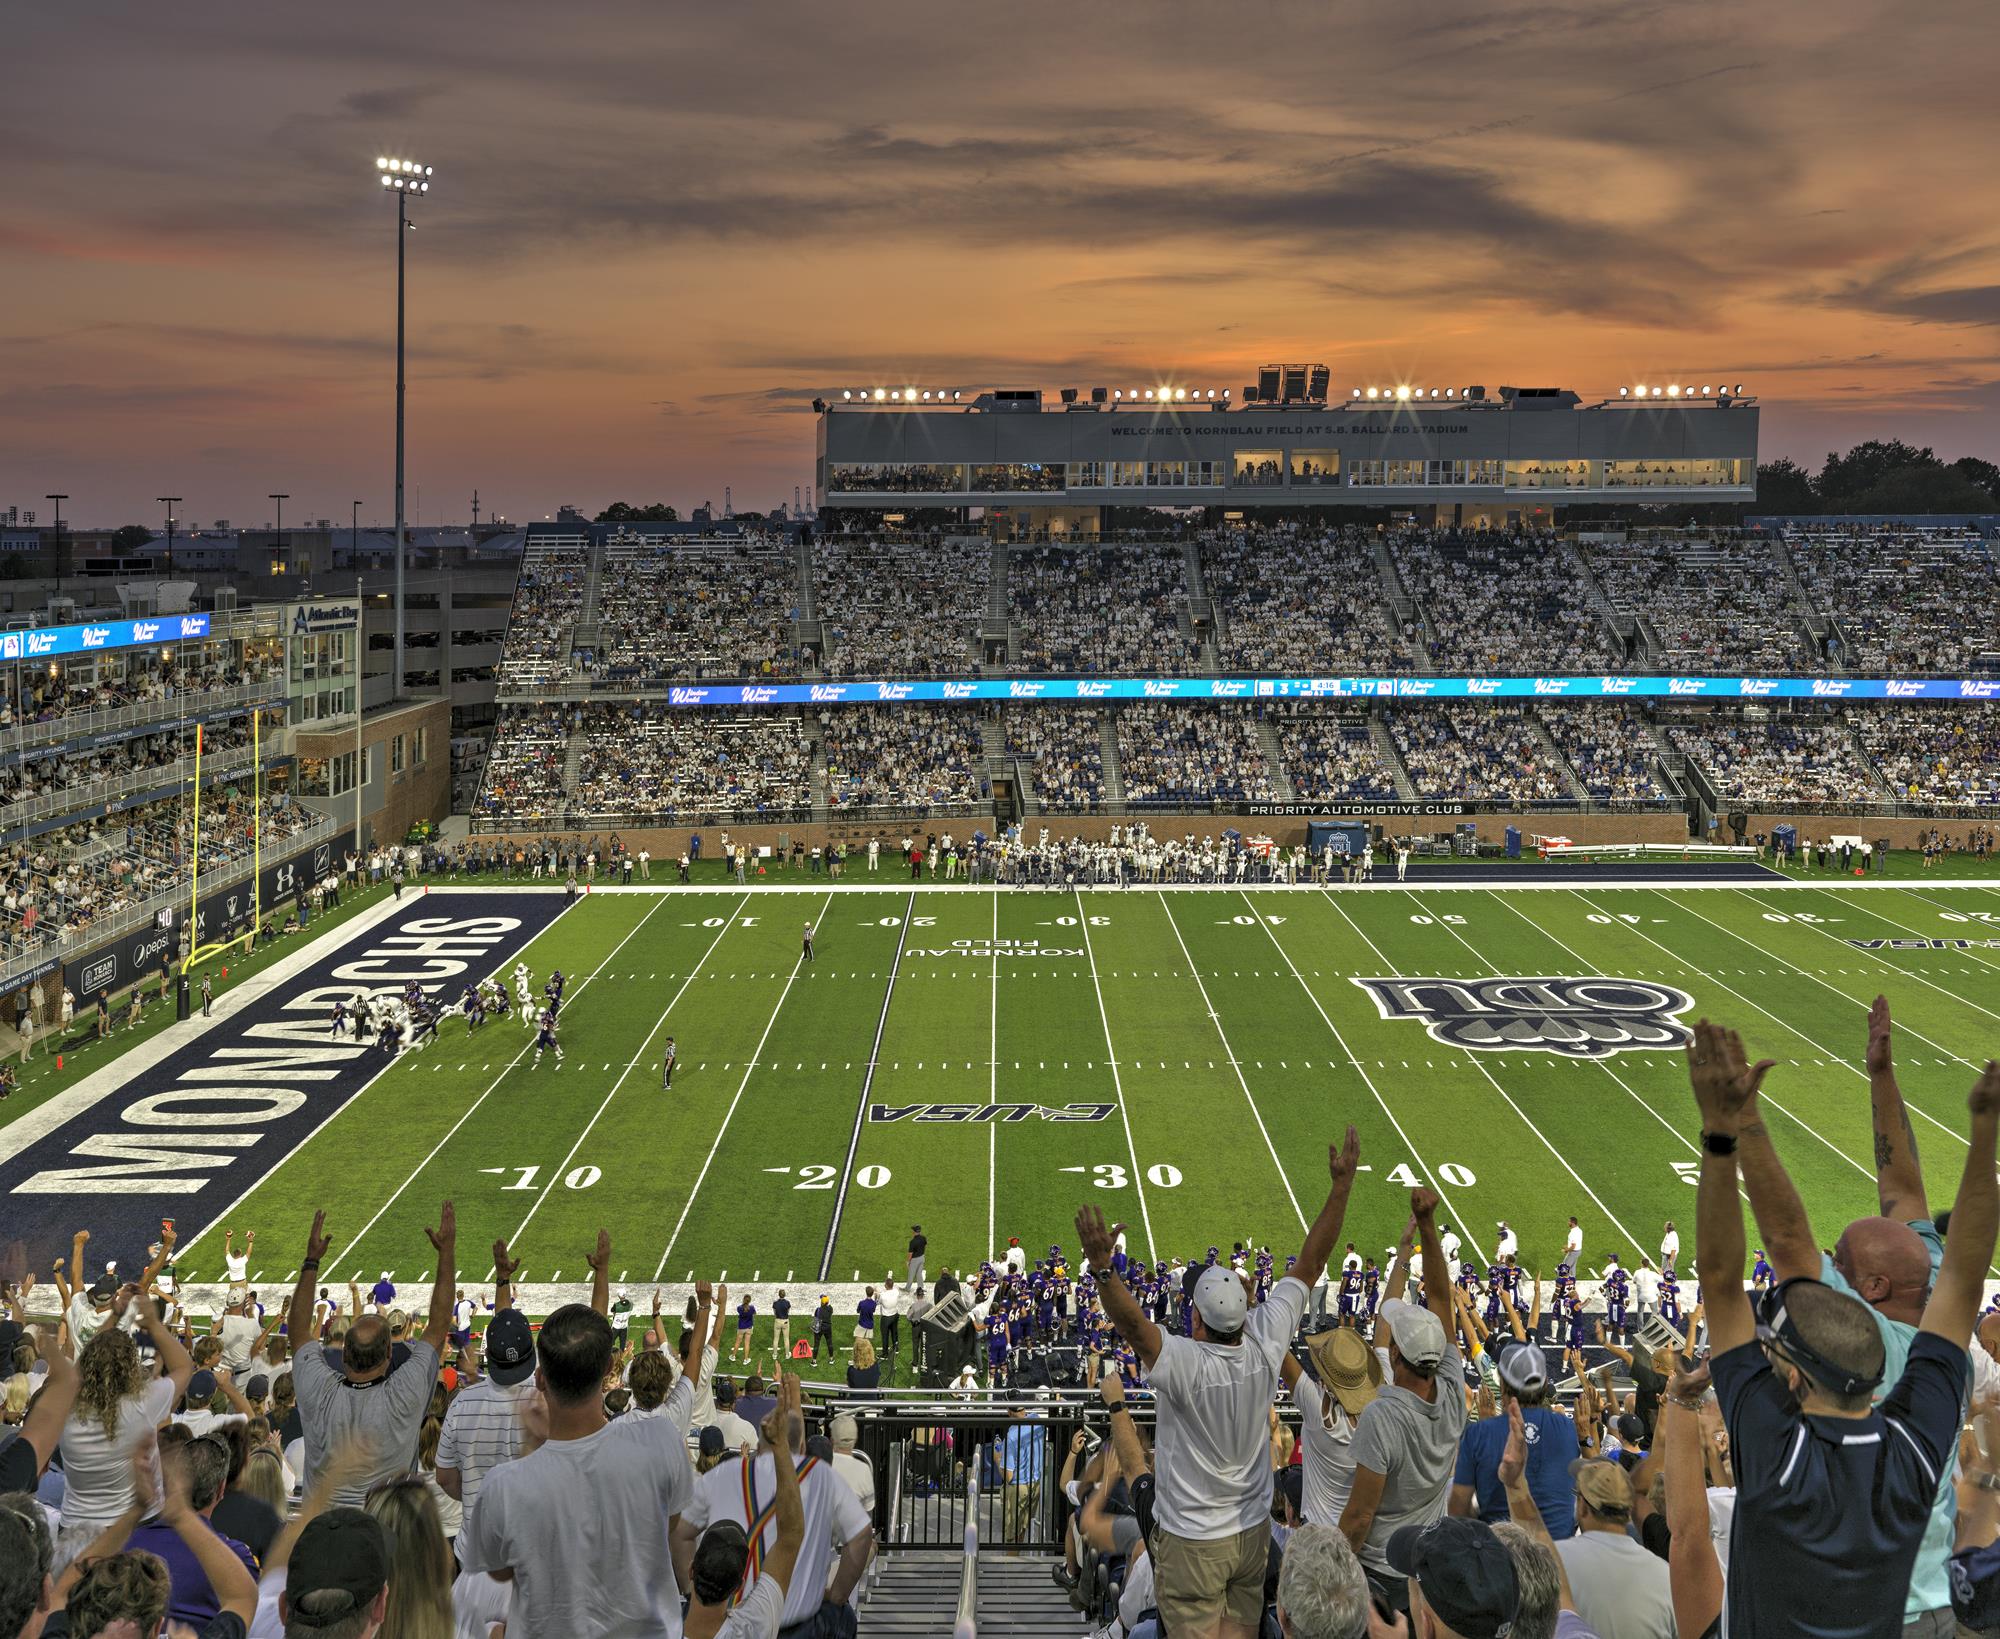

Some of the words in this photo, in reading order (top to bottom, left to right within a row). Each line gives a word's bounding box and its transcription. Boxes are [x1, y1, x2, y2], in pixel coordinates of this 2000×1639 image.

[1111, 427, 1173, 436] WELCOME
[1177, 427, 1191, 436] TO
[1195, 427, 1263, 436] KORNBLAU
[1266, 426, 1303, 435] FIELD
[1306, 426, 1322, 435] AT
[1325, 426, 1348, 434] S.B.
[1352, 426, 1409, 434] BALLARD
[1413, 426, 1468, 434] STADIUM
[1280, 682, 1289, 695] 3
[1360, 682, 1375, 695] 17
[208, 712, 228, 720] PRIORITY
[159, 722, 180, 730] PRIORITY
[94, 735, 116, 743] PRIORITY
[18, 751, 42, 759] PRIORITY
[44, 745, 67, 755] HYUNDAI
[229, 767, 253, 779] GRIDIRON
[253, 764, 264, 774] CUB
[112, 802, 124, 811] PNC
[1250, 806, 1316, 815] PRIORITY
[1321, 805, 1420, 815] AUTOMOTIVE
[1426, 805, 1462, 814] CLUB
[158, 908, 172, 927] 40
[702, 916, 761, 928] 10
[879, 916, 938, 927] 20
[1056, 915, 1112, 927] 30
[1233, 914, 1288, 926] 40
[1410, 914, 1469, 925] 50
[1586, 913, 1642, 925] 40
[1762, 912, 1826, 924] 30
[146, 932, 170, 959] pepsi
[952, 939, 1040, 947] FIELD
[906, 948, 1084, 957] KORNBLAU
[93, 960, 113, 976] TEAM
[5, 978, 21, 990] GAME
[21, 972, 33, 982] DAY
[33, 963, 55, 976] TUNNEL
[1366, 979, 1684, 1013] ODU
[10, 916, 523, 1194] MONARCHS
[500, 1164, 602, 1190] 10
[793, 1164, 892, 1190] 20
[1092, 1163, 1183, 1189] 30
[1385, 1162, 1477, 1188] 40
[1669, 1162, 1701, 1186] 5
[1509, 1275, 1516, 1286] 5
[1043, 1287, 1055, 1300] 67
[1661, 1290, 1673, 1303] 52
[1008, 1307, 1020, 1322] 66
